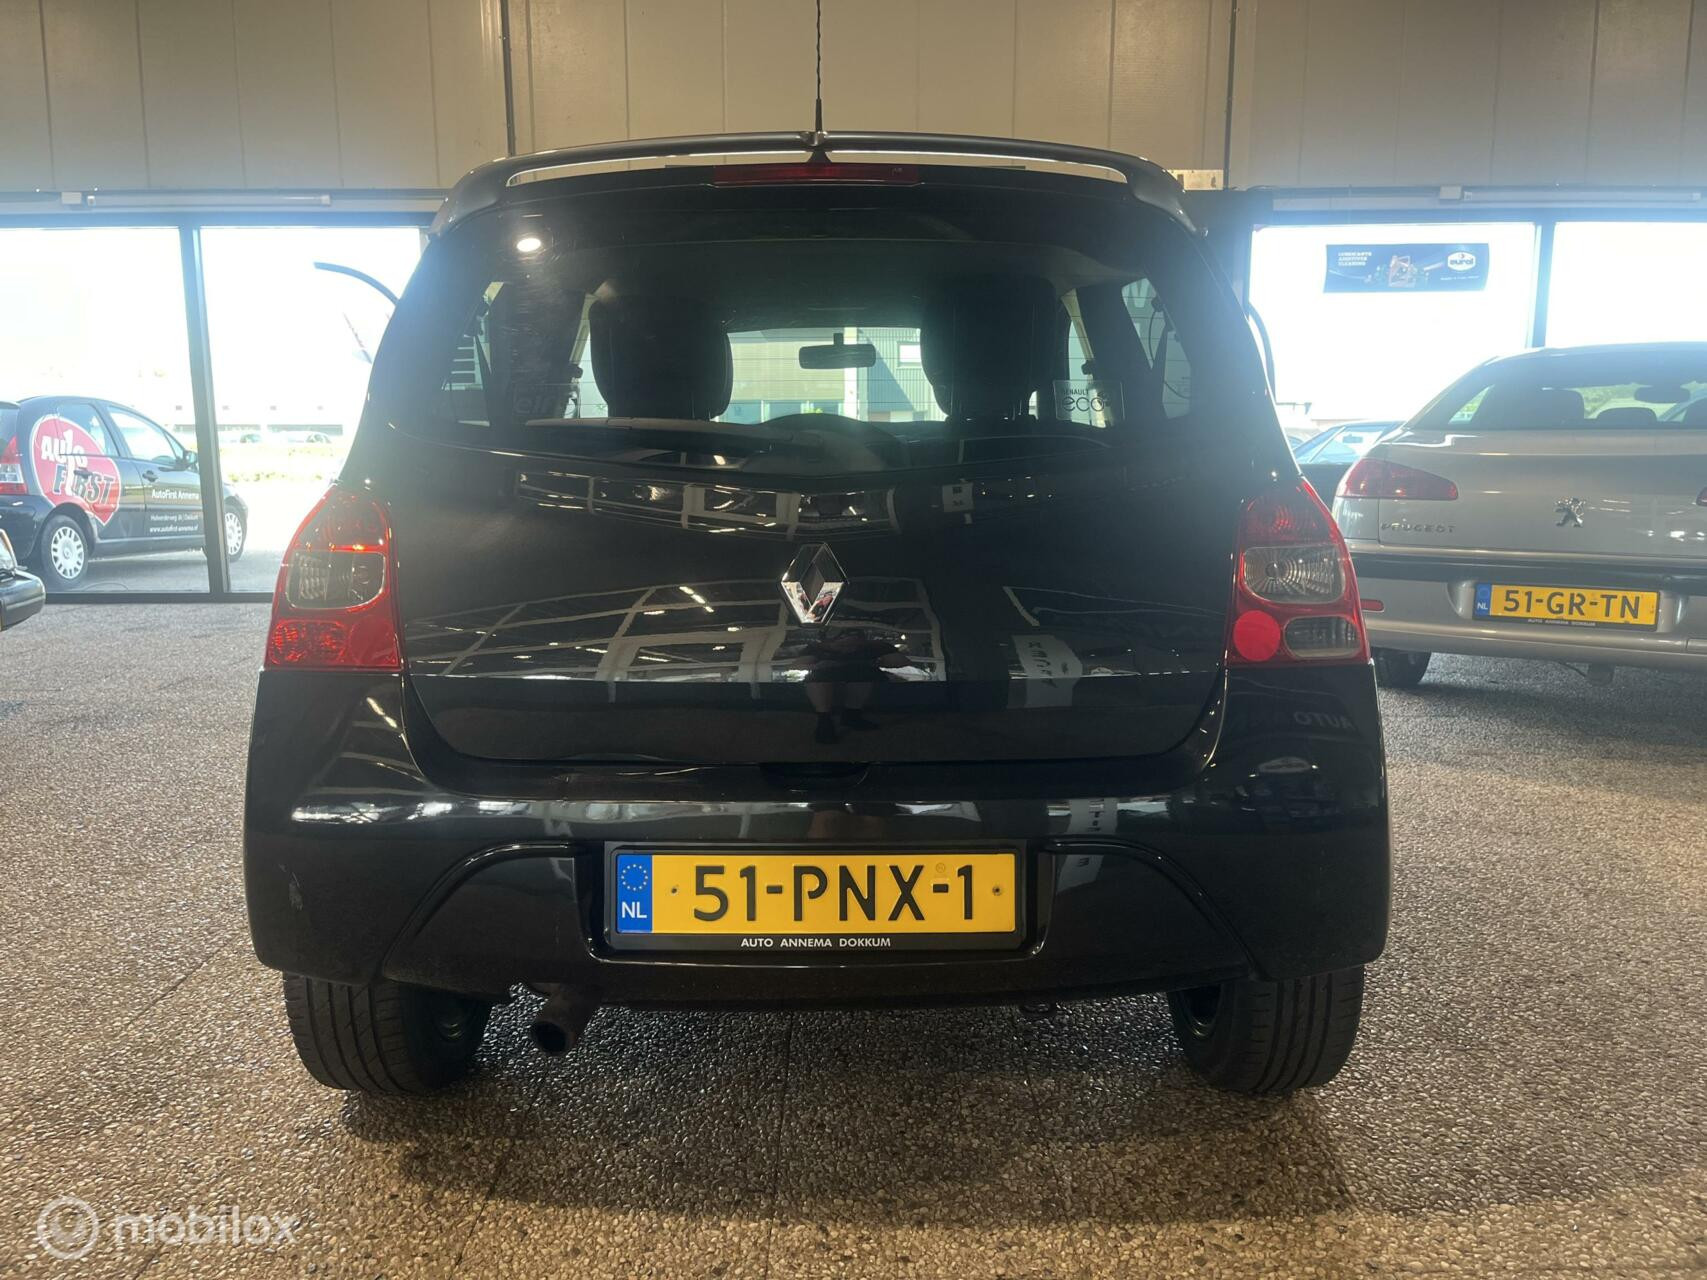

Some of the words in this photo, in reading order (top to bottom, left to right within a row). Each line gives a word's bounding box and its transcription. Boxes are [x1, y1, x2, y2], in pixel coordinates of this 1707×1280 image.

[1477, 601, 1489, 611] NL
[1503, 589, 1641, 620] 51-GR-TN
[621, 901, 647, 919] NL
[693, 864, 974, 923] 51-PNX-1
[740, 938, 774, 948] AUTO
[779, 938, 833, 948] ANNEMA
[839, 938, 891, 948] DOKKUM
